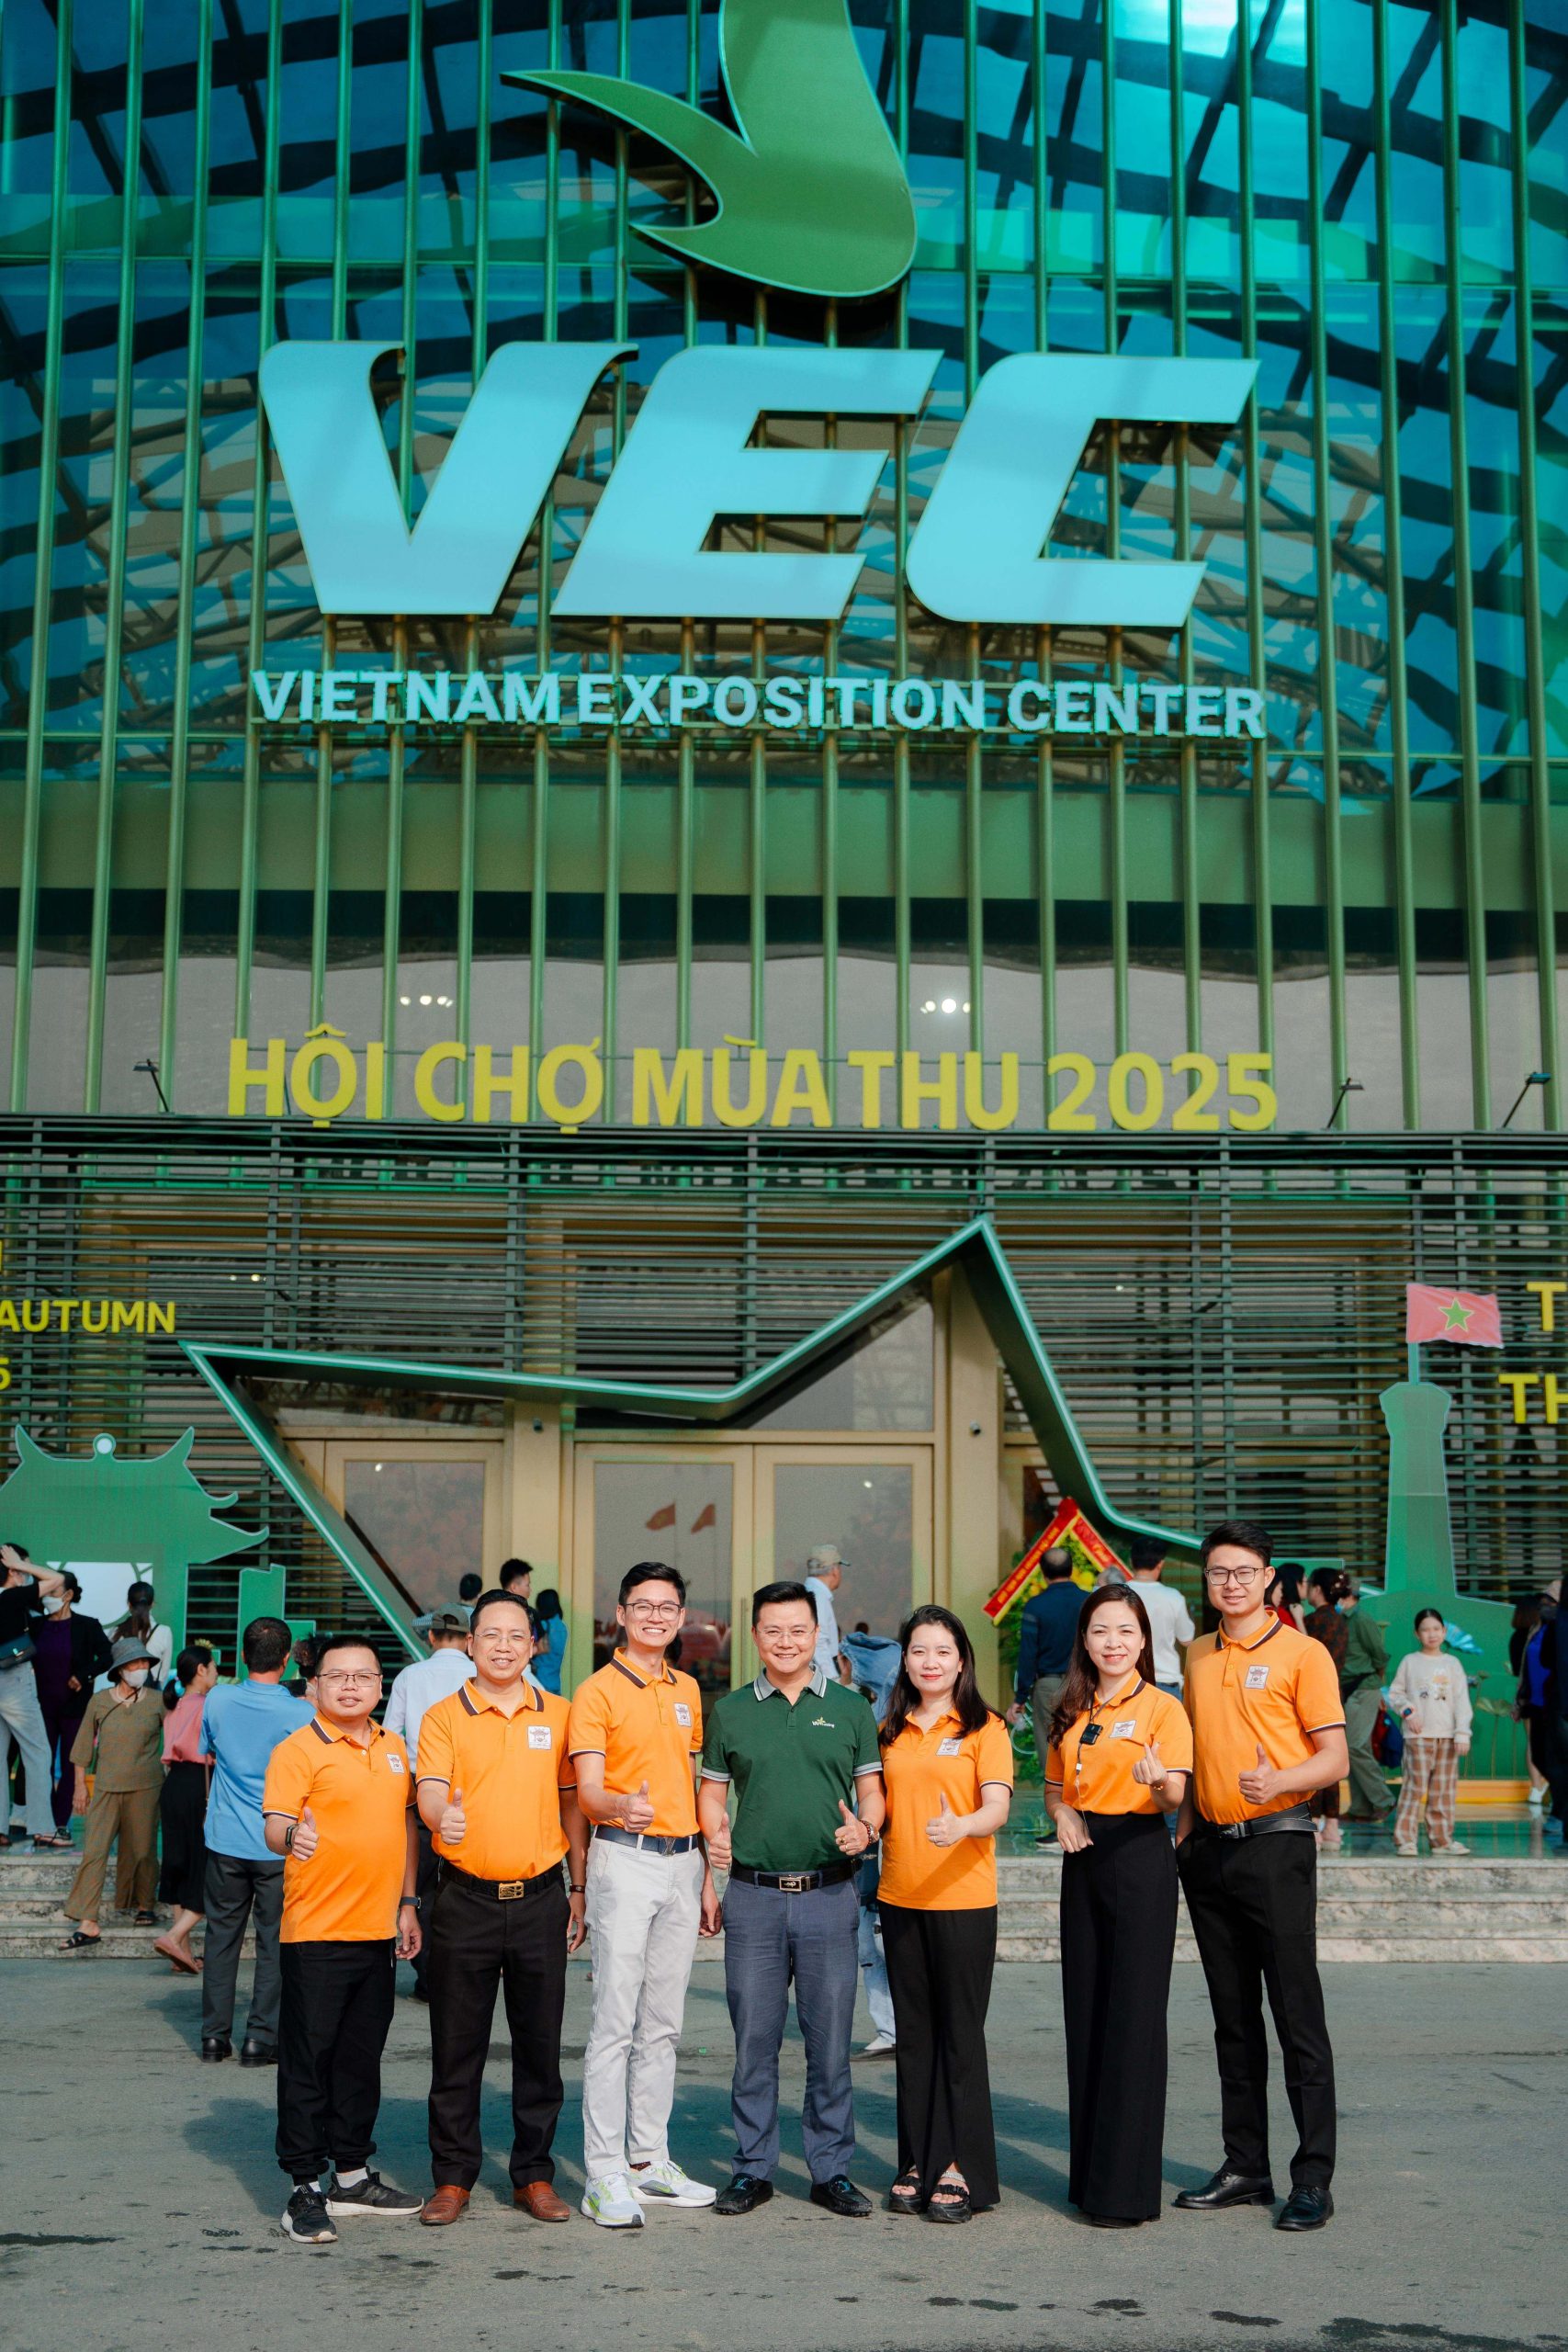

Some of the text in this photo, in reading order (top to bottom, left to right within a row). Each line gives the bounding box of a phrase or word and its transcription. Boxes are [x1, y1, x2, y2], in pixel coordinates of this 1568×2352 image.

[258, 340, 1262, 628] VEC
[252, 669, 1266, 740] VIETNAM EXPOSITION CENTER
[228, 1022, 1278, 1134] HỘI CHỢ MÙA THU 2025
[0, 1298, 176, 1334] AUTUMN
